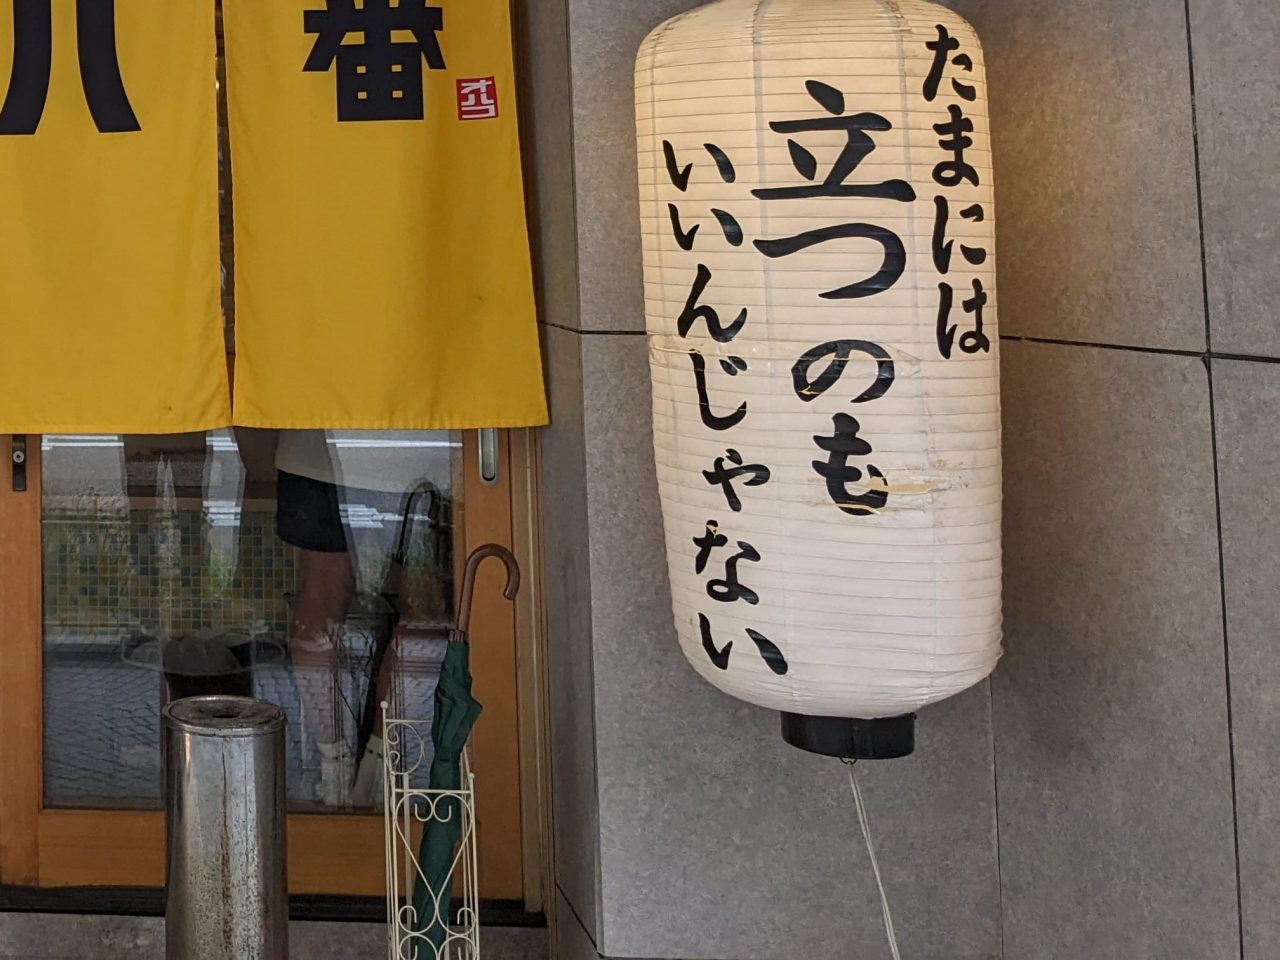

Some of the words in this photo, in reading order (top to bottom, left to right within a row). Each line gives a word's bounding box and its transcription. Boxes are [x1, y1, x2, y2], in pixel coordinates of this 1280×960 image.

[662, 139, 789, 676] いいんじゃない
[752, 79, 917, 517] 立つのも
[923, 24, 991, 360] たまには
